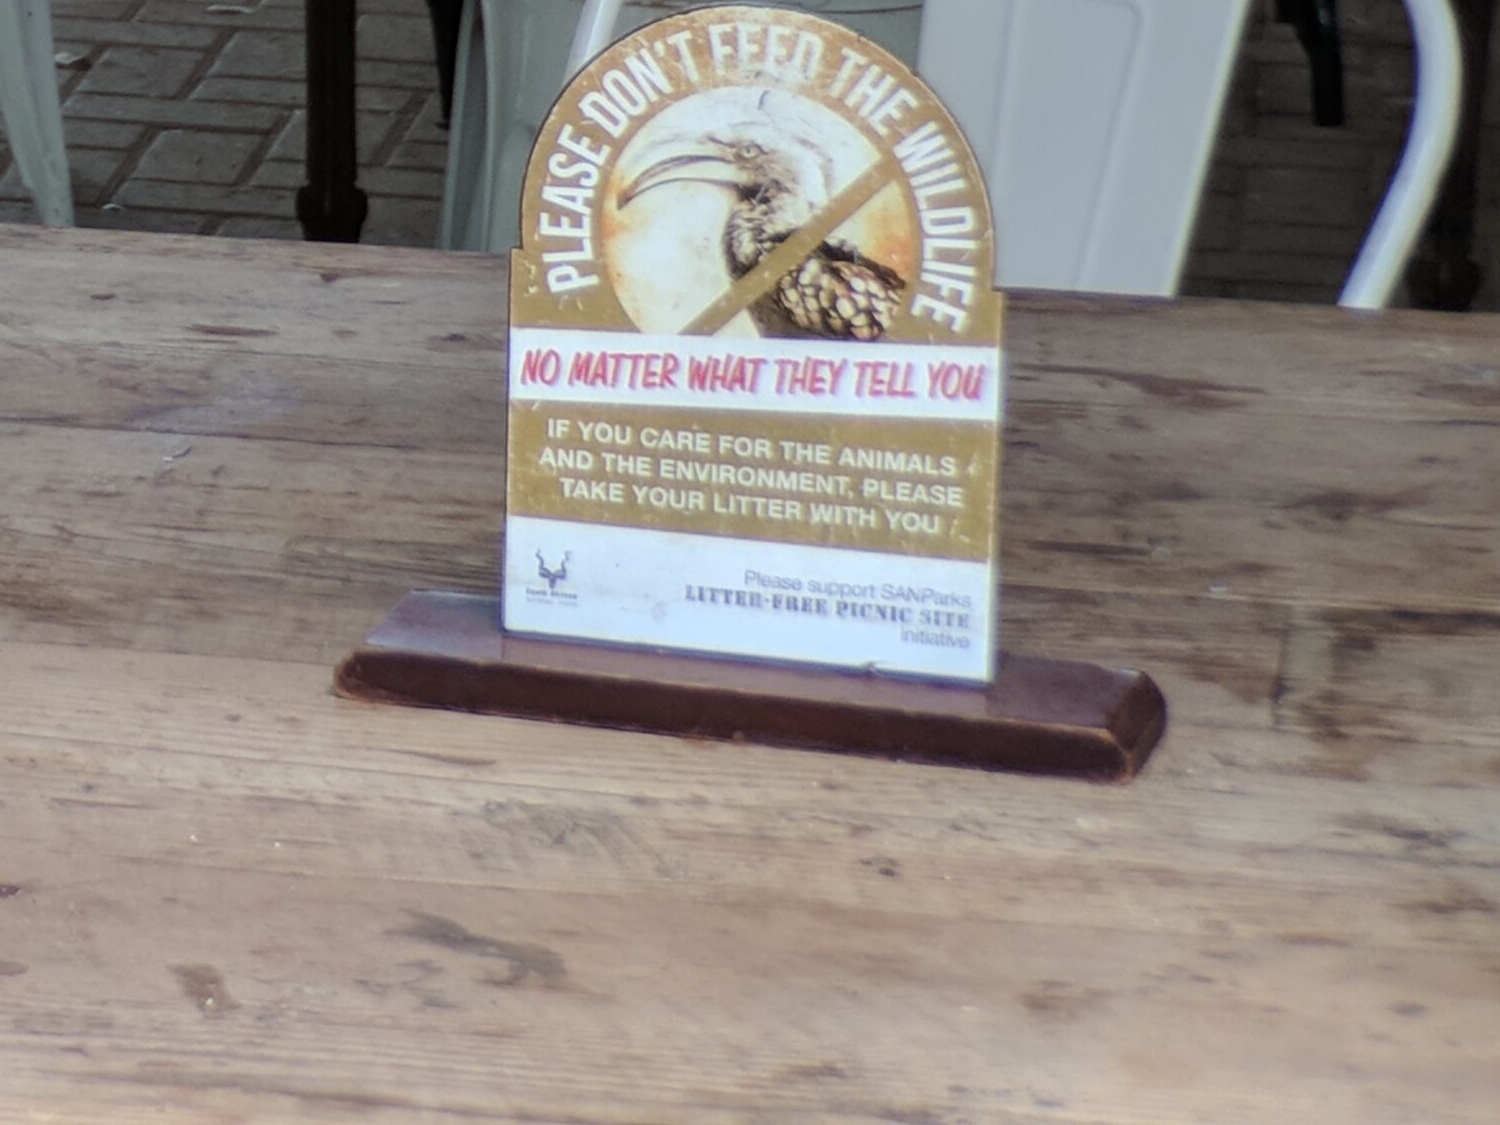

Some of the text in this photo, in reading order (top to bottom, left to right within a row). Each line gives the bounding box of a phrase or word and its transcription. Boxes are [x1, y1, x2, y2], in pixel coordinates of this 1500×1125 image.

[540, 22, 978, 333] PLEASE DON'T FEED THE WILDLIFE
[520, 348, 987, 400] NO MATTER WHAT THEY TELL YOU
[548, 418, 956, 477] IF YOU CARE FOR THE ANIMALS
[538, 446, 594, 471] AND
[601, 452, 653, 477] THE
[861, 477, 965, 509] PLEASE
[560, 477, 941, 536] TAKE YOUR LITTER WITH YOU
[684, 583, 970, 630] LITTER-FREE PICNIC SITE
[744, 569, 971, 608] Please support SANParks
[900, 624, 971, 649] initiative
